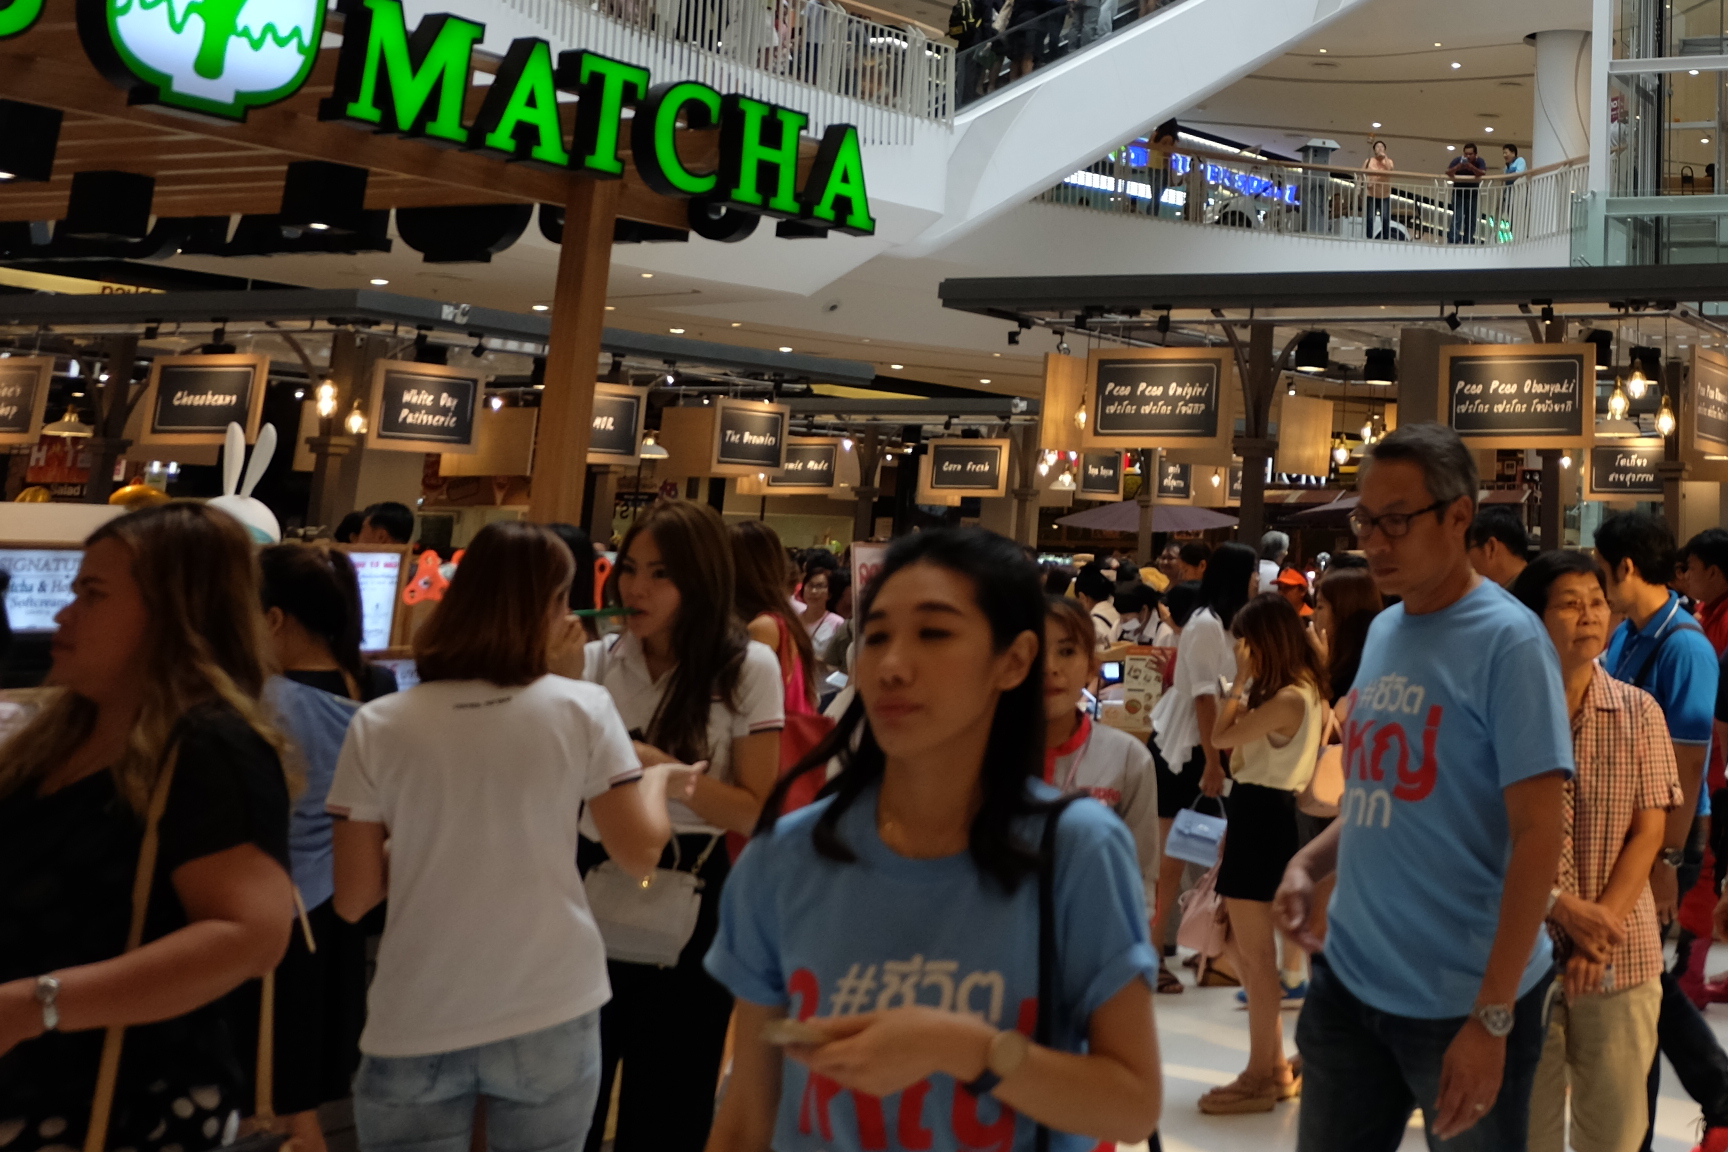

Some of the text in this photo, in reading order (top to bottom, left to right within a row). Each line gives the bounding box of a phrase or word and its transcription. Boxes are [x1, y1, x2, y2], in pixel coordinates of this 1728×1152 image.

[402, 389, 459, 411] White Day
[398, 408, 458, 428] Patisserie
[966, 460, 990, 473] Fresh
